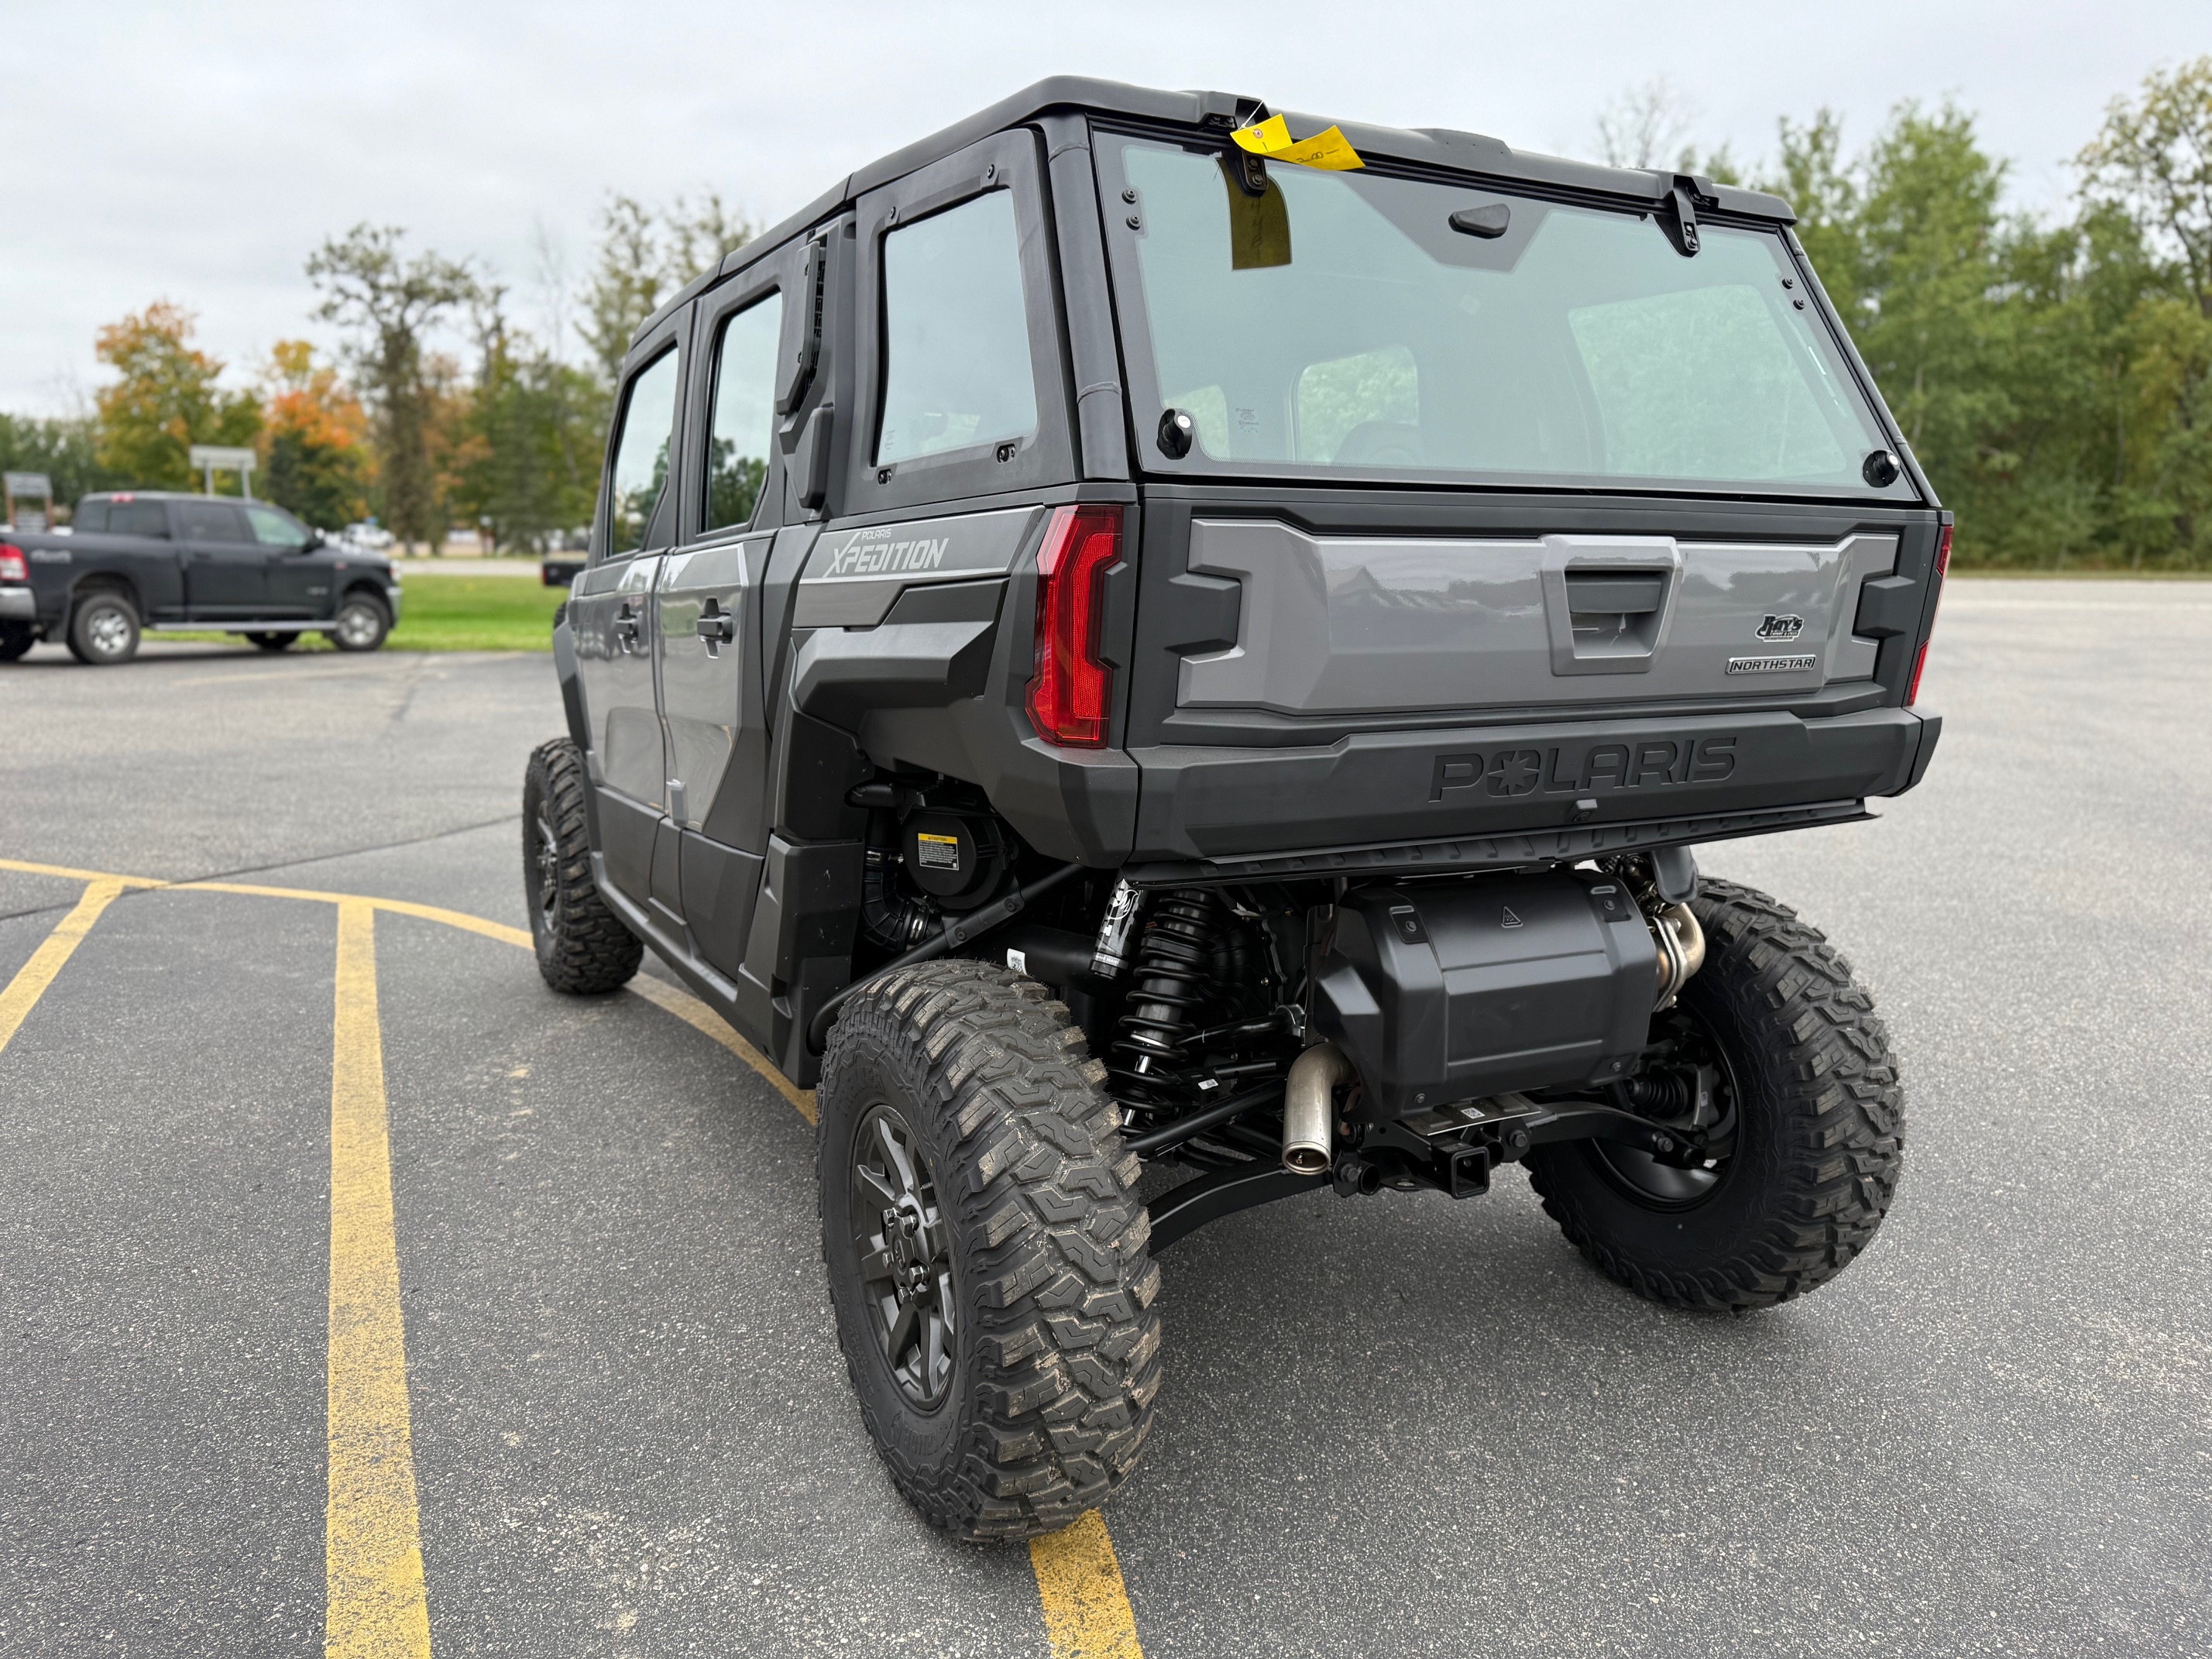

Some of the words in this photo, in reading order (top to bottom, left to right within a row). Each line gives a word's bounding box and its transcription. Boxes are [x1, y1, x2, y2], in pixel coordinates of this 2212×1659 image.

[861, 529, 891, 541] POLARIS
[823, 532, 950, 578] XPEDITION
[1733, 659, 1812, 671] NORTHSTAR
[1428, 737, 1736, 803] POLARIS
